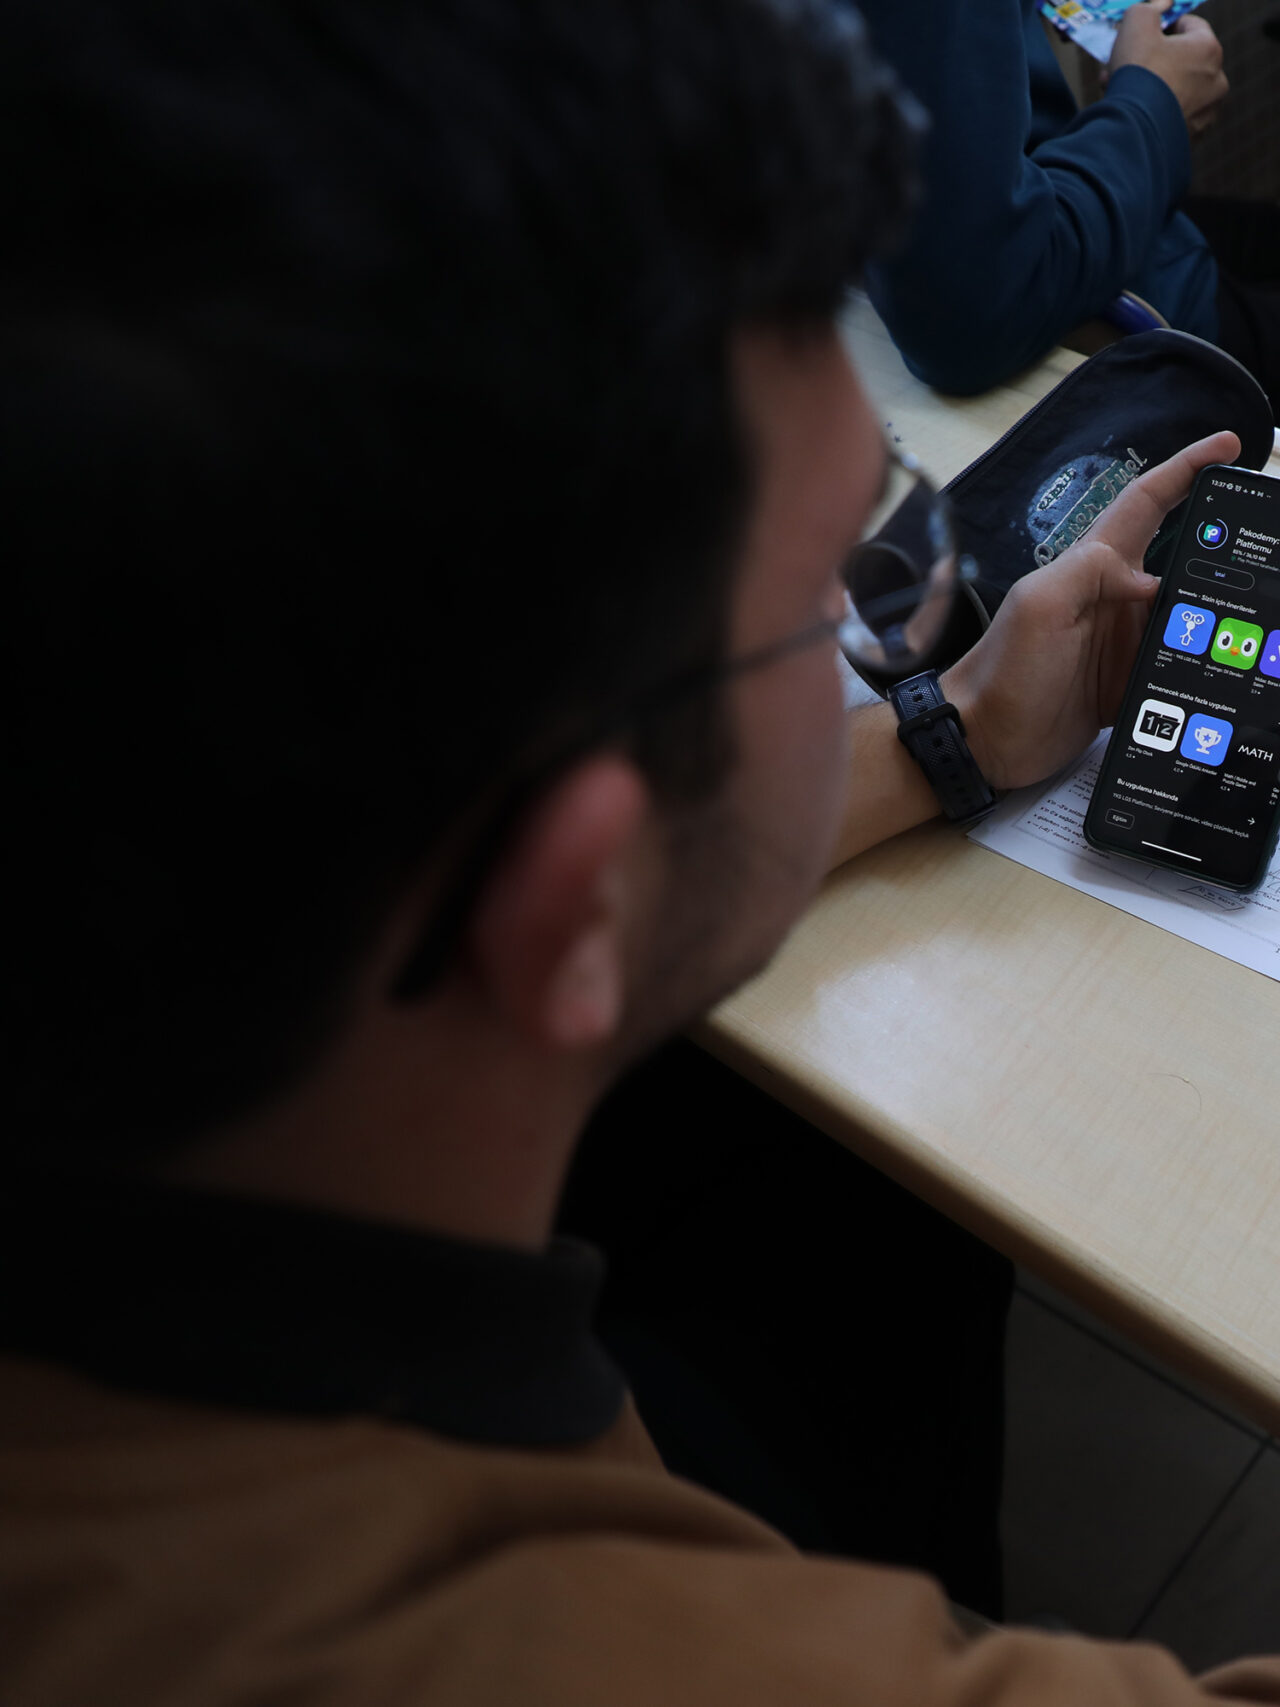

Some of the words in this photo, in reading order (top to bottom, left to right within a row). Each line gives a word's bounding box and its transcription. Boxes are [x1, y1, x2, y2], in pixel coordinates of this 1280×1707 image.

[1092, 448, 1147, 504] Fuel
[1211, 479, 1226, 488] 13:37
[1238, 527, 1280, 545] Pakodemy:
[1235, 537, 1272, 554] Platformu
[1200, 594, 1215, 603] Sizin
[1214, 598, 1226, 607] için
[1225, 601, 1257, 615] önerilenler
[1147, 682, 1179, 697] Denenecek
[1178, 691, 1194, 701] daha
[1193, 696, 1208, 705] fazla
[1207, 700, 1236, 714] uygulama
[1147, 715, 1154, 730] 1
[1160, 723, 1172, 736] 2
[1237, 744, 1273, 762] MATH
[1116, 777, 1125, 785] Bu
[1124, 780, 1153, 794] uygulama
[1152, 788, 1179, 802] hakkında
[1111, 814, 1128, 823] Eğitim
[1173, 811, 1184, 819] göre
